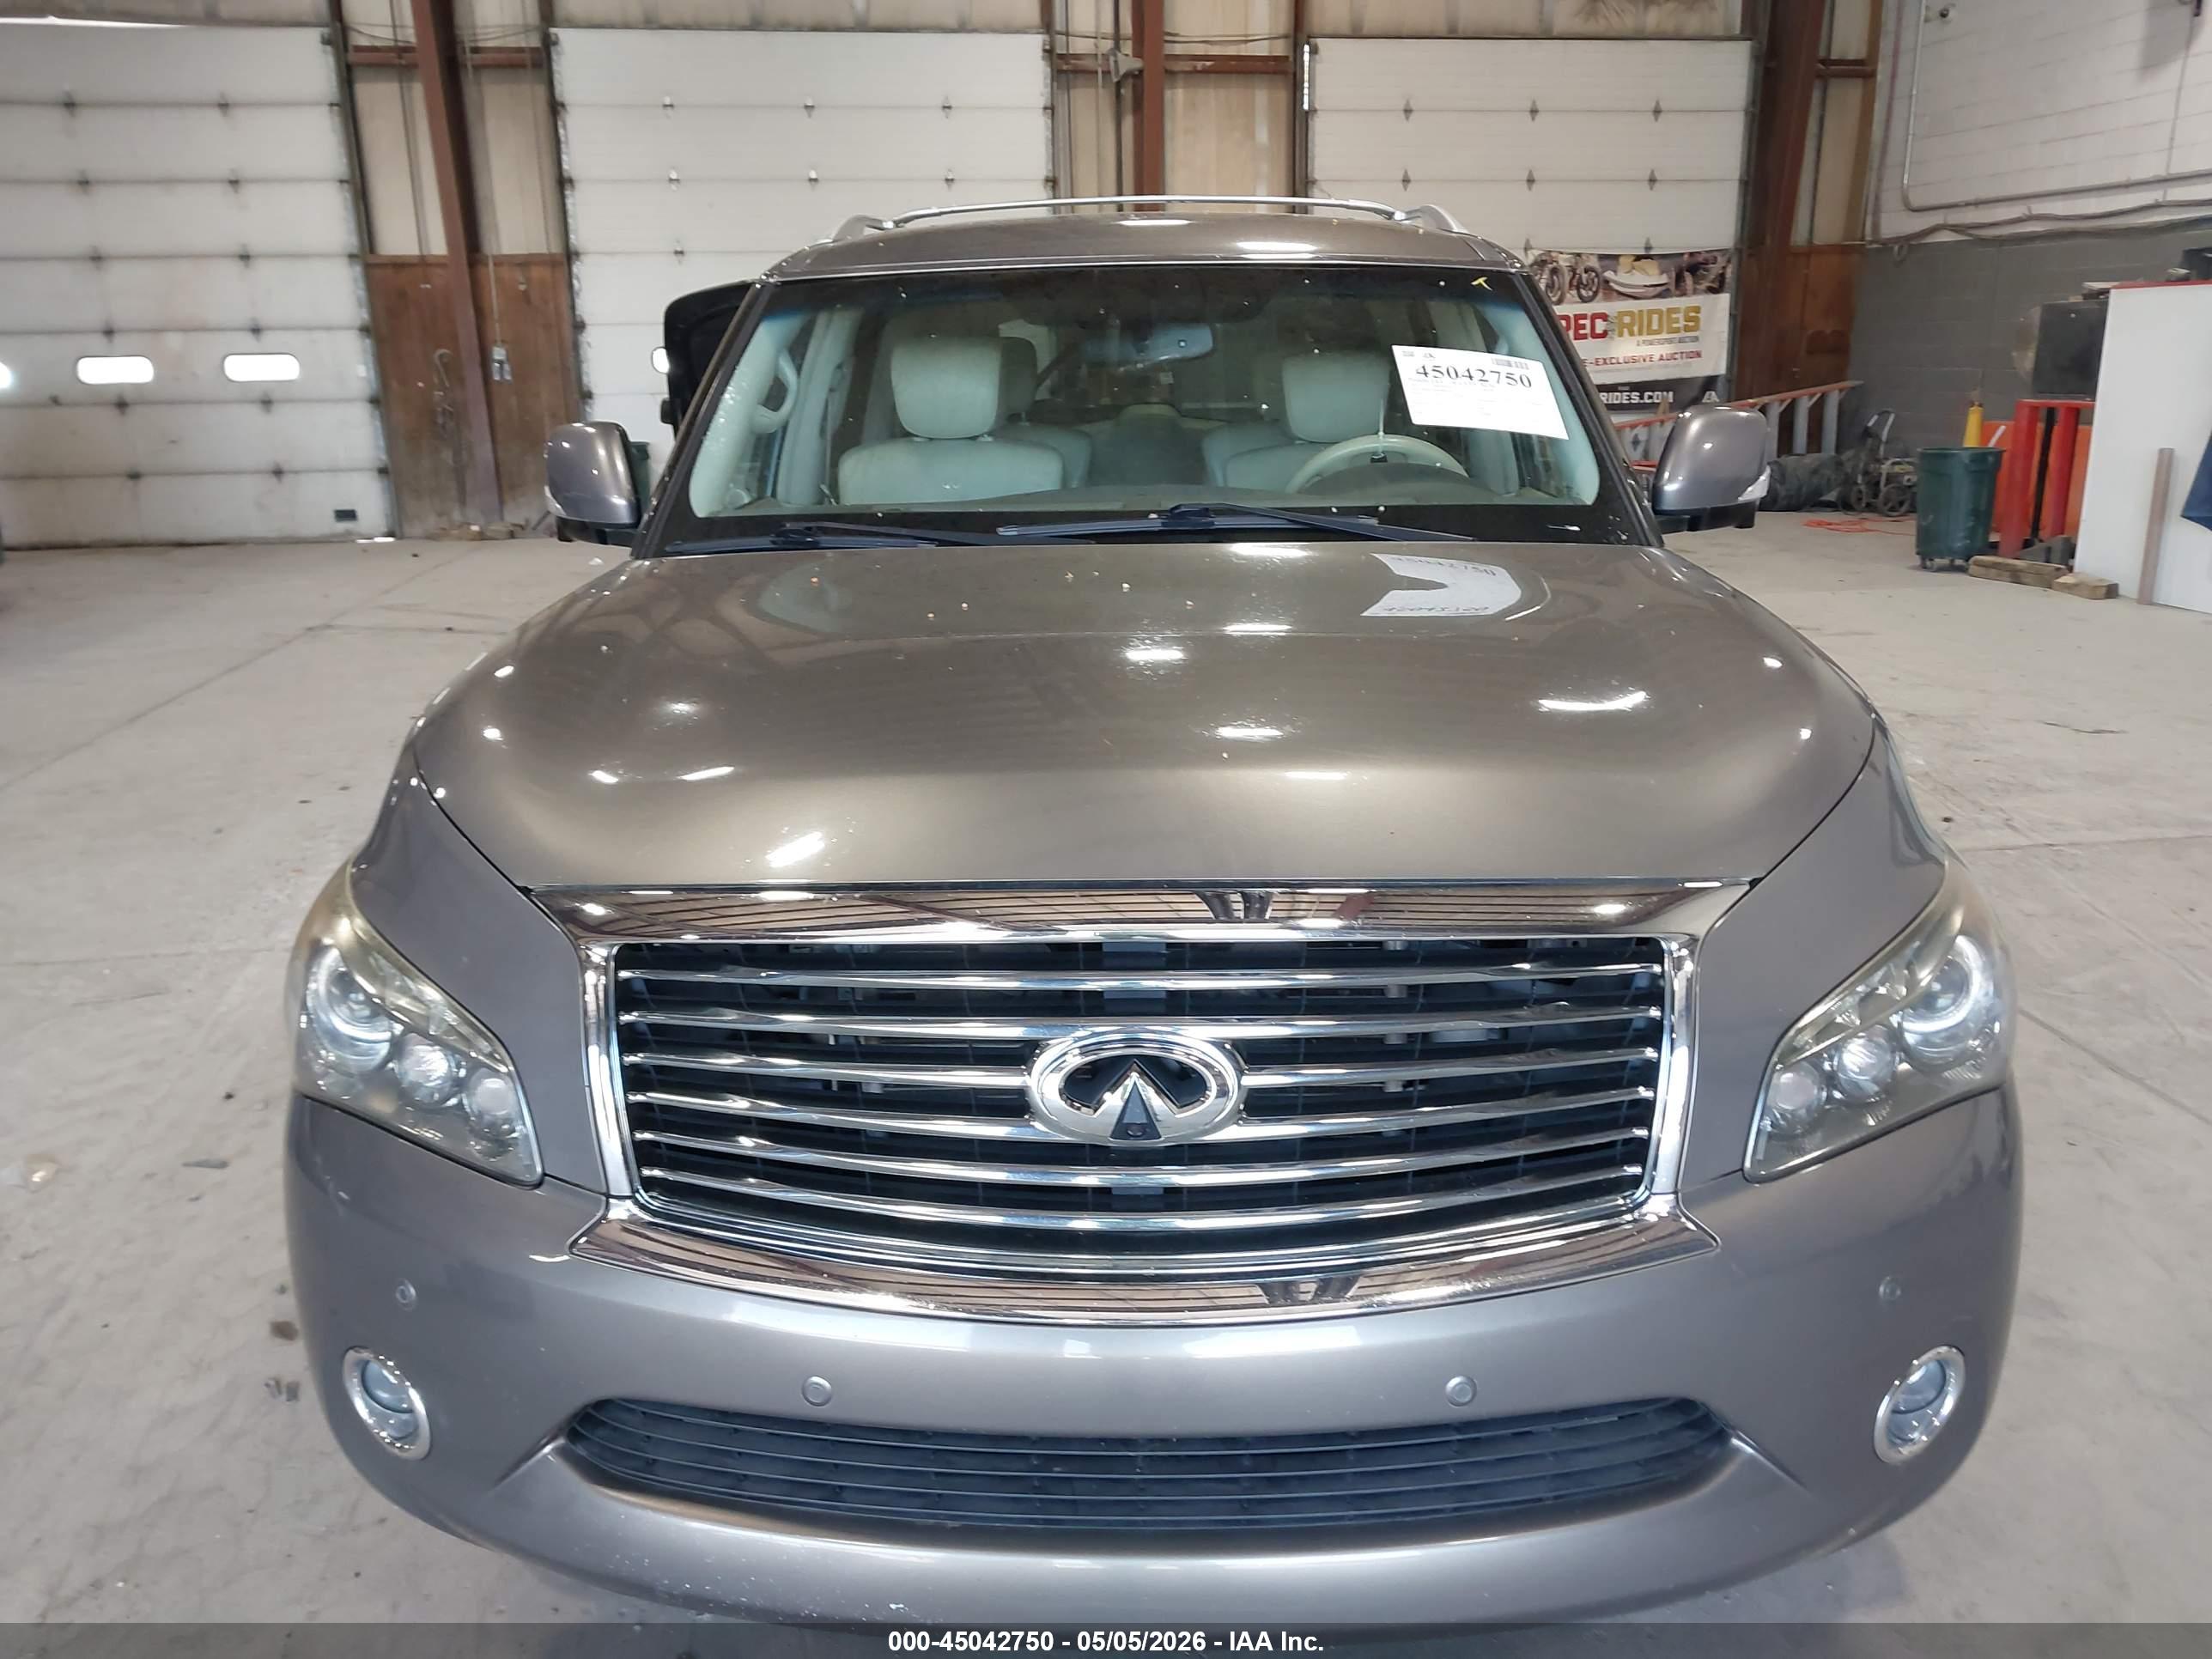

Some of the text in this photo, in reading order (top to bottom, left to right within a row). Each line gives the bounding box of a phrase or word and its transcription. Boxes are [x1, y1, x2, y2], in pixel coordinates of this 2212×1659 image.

[1616, 305, 1702, 338] RIDES
[1658, 349, 1702, 362] AUCTION
[1415, 364, 1532, 388] 45042750
